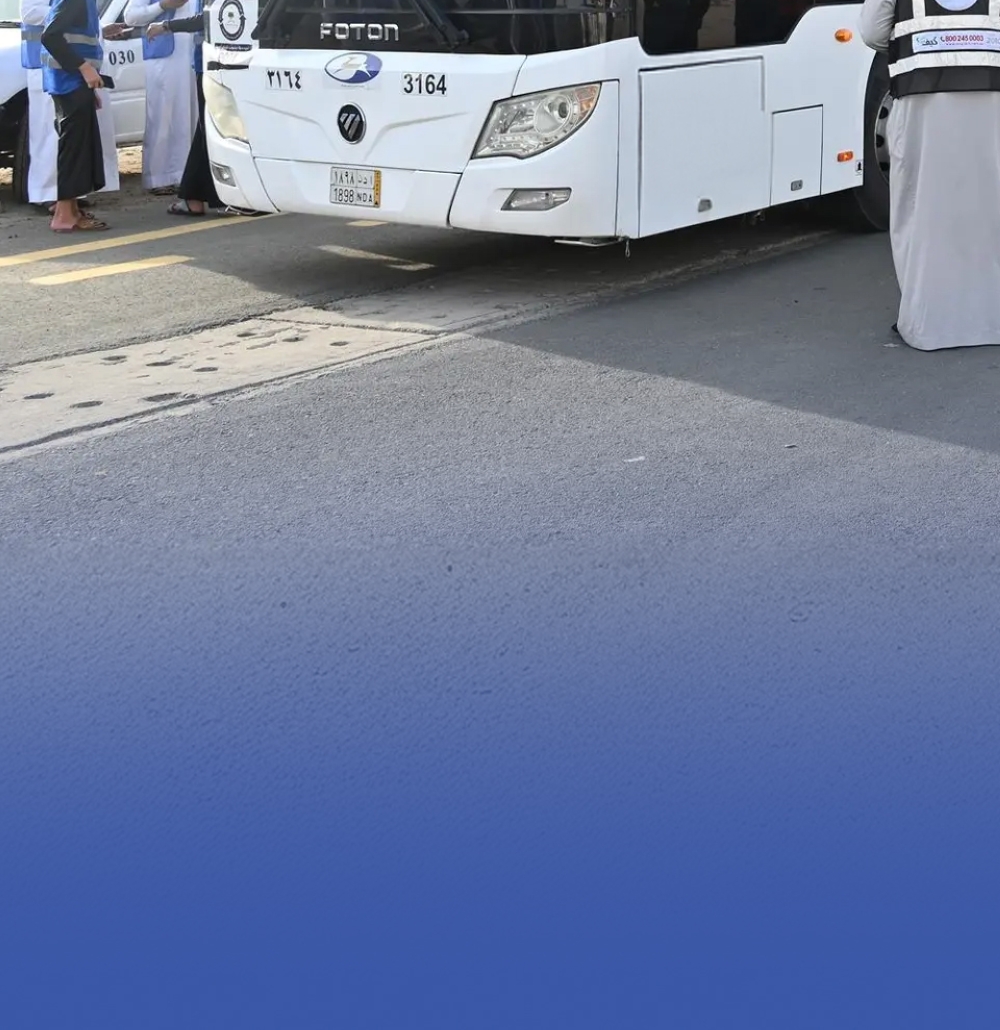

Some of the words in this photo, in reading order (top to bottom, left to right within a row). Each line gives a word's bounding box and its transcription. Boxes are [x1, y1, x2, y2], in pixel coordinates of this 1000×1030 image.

[320, 23, 399, 41] FOTON
[109, 50, 135, 65] 030
[267, 70, 302, 89] ٣١٦٤
[403, 73, 447, 95] 3164
[334, 188, 354, 203] 1898
[357, 192, 372, 202] NDA
